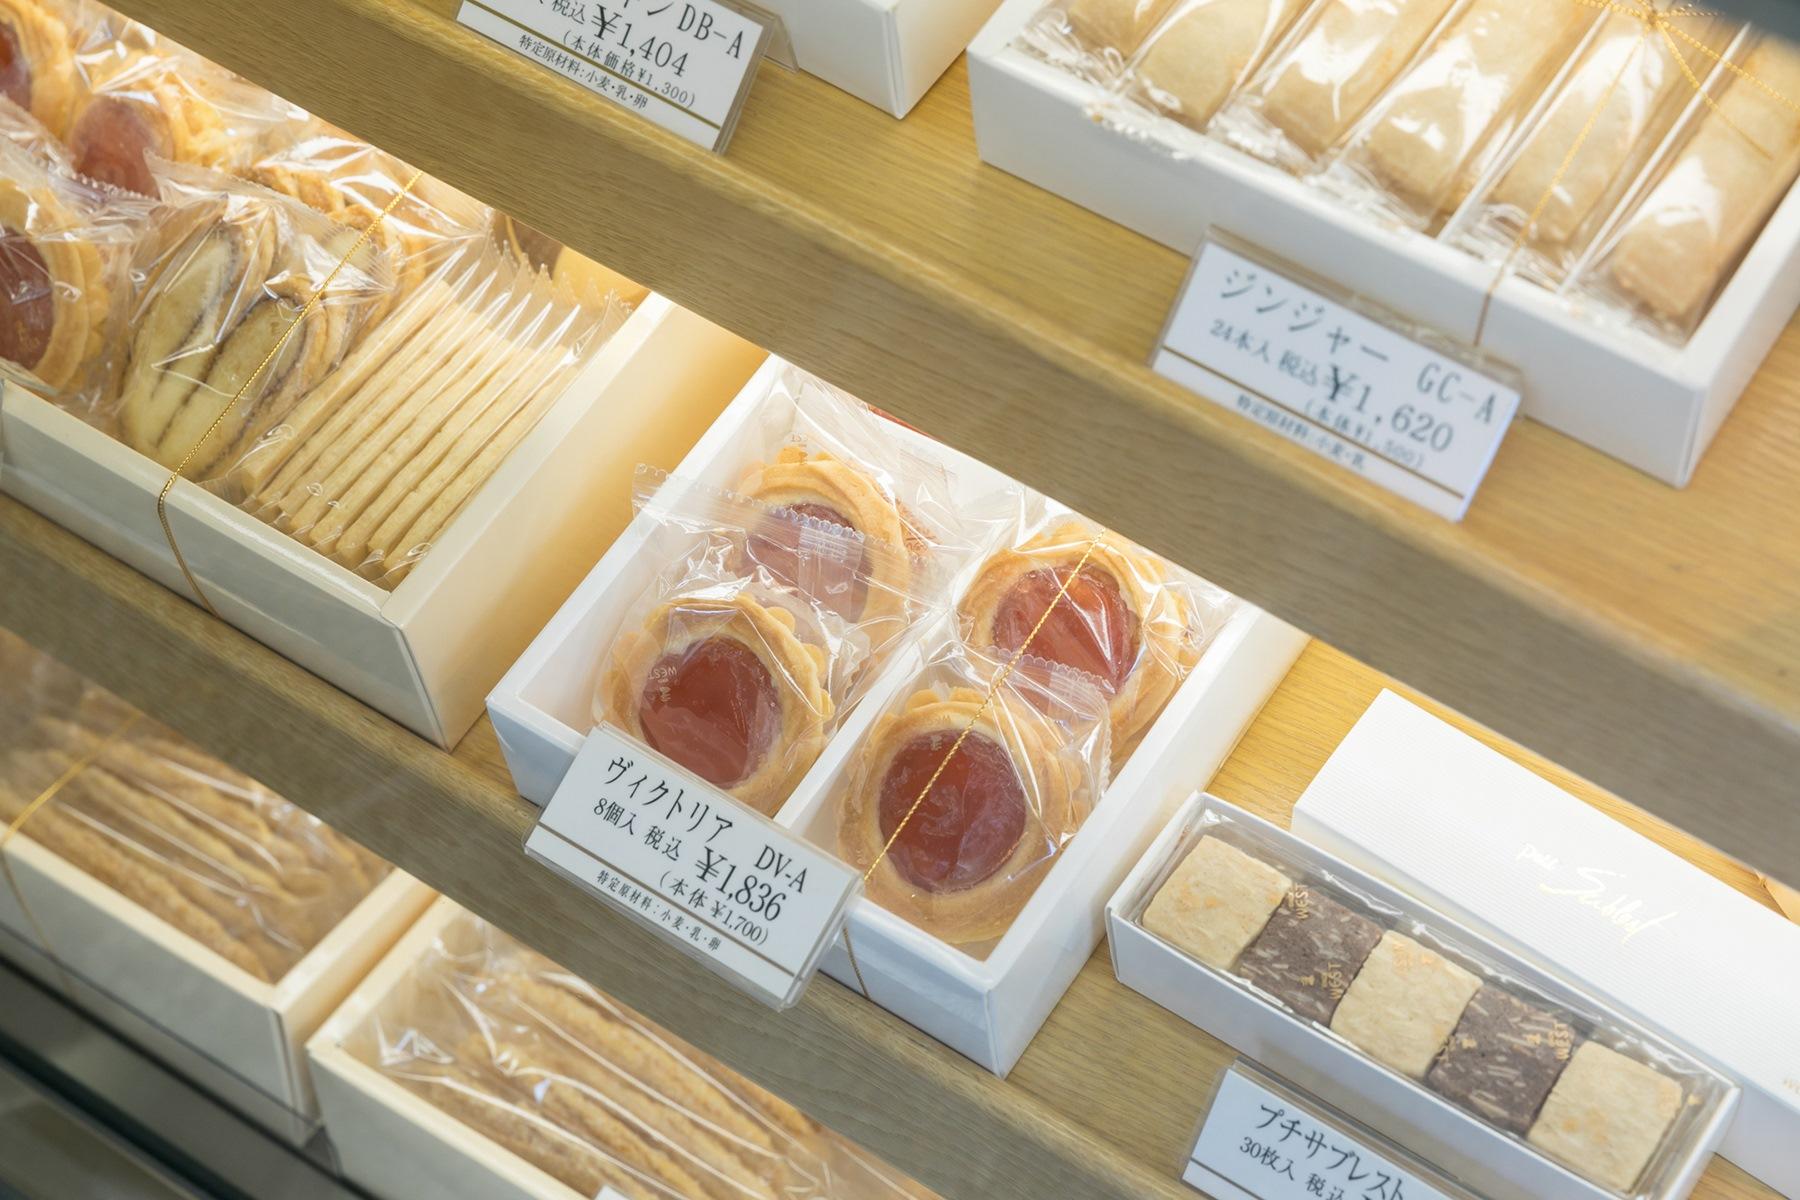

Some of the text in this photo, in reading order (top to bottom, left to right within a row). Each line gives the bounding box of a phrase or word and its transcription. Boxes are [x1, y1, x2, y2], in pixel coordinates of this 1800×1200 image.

[677, 3, 744, 59] DB-A
[1210, 319, 1270, 364] 24本入
[1221, 270, 1496, 425] ジンジャー GC-A
[648, 666, 677, 680] WEST
[605, 756, 808, 894] ヴィクトリア DV-A
[594, 797, 787, 922] 8個入 税込 ¥1,836
[1239, 1136, 1295, 1181] 30枚入
